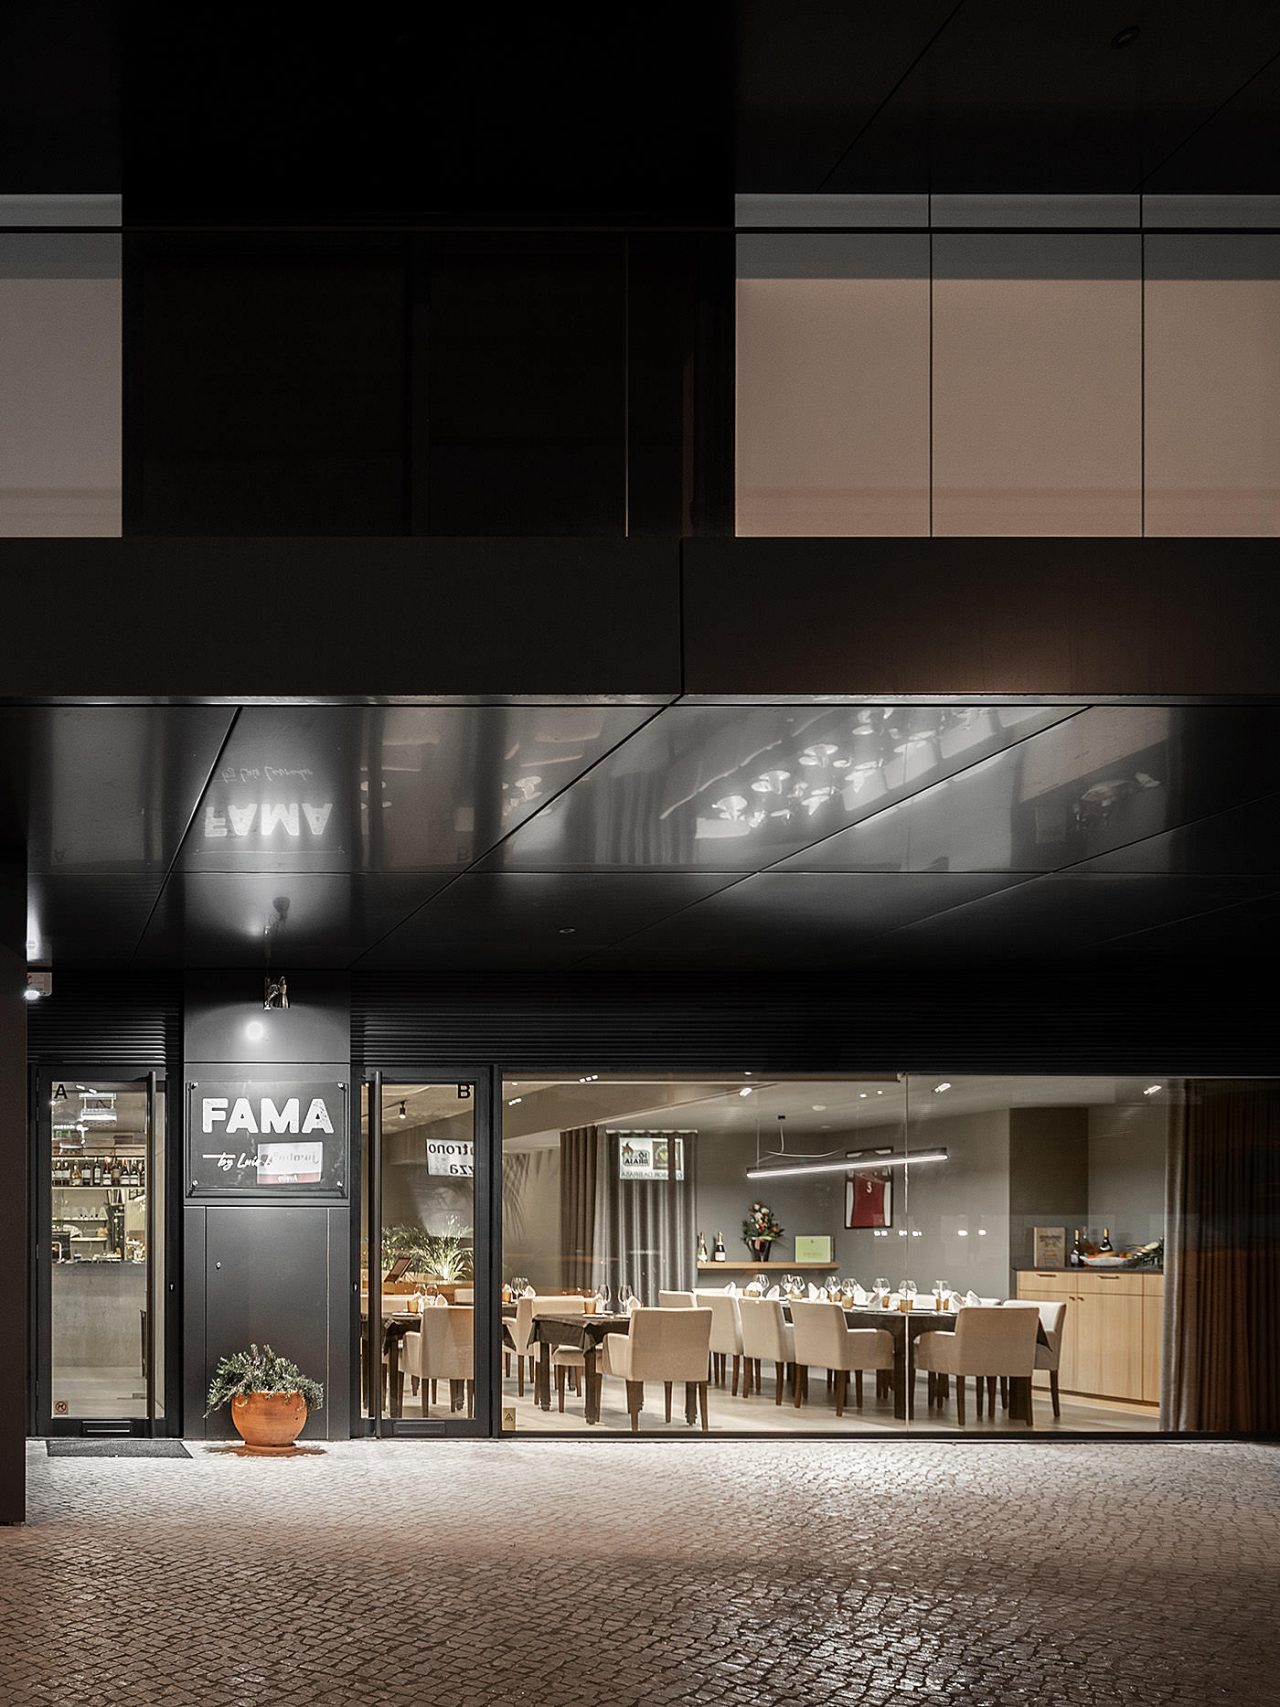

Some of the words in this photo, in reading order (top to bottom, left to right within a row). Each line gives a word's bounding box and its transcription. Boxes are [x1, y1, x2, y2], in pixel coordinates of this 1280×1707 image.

[54, 1084, 68, 1099] A
[457, 1083, 470, 1098] B
[202, 1098, 334, 1134] FAMA
[217, 1152, 234, 1171] by
